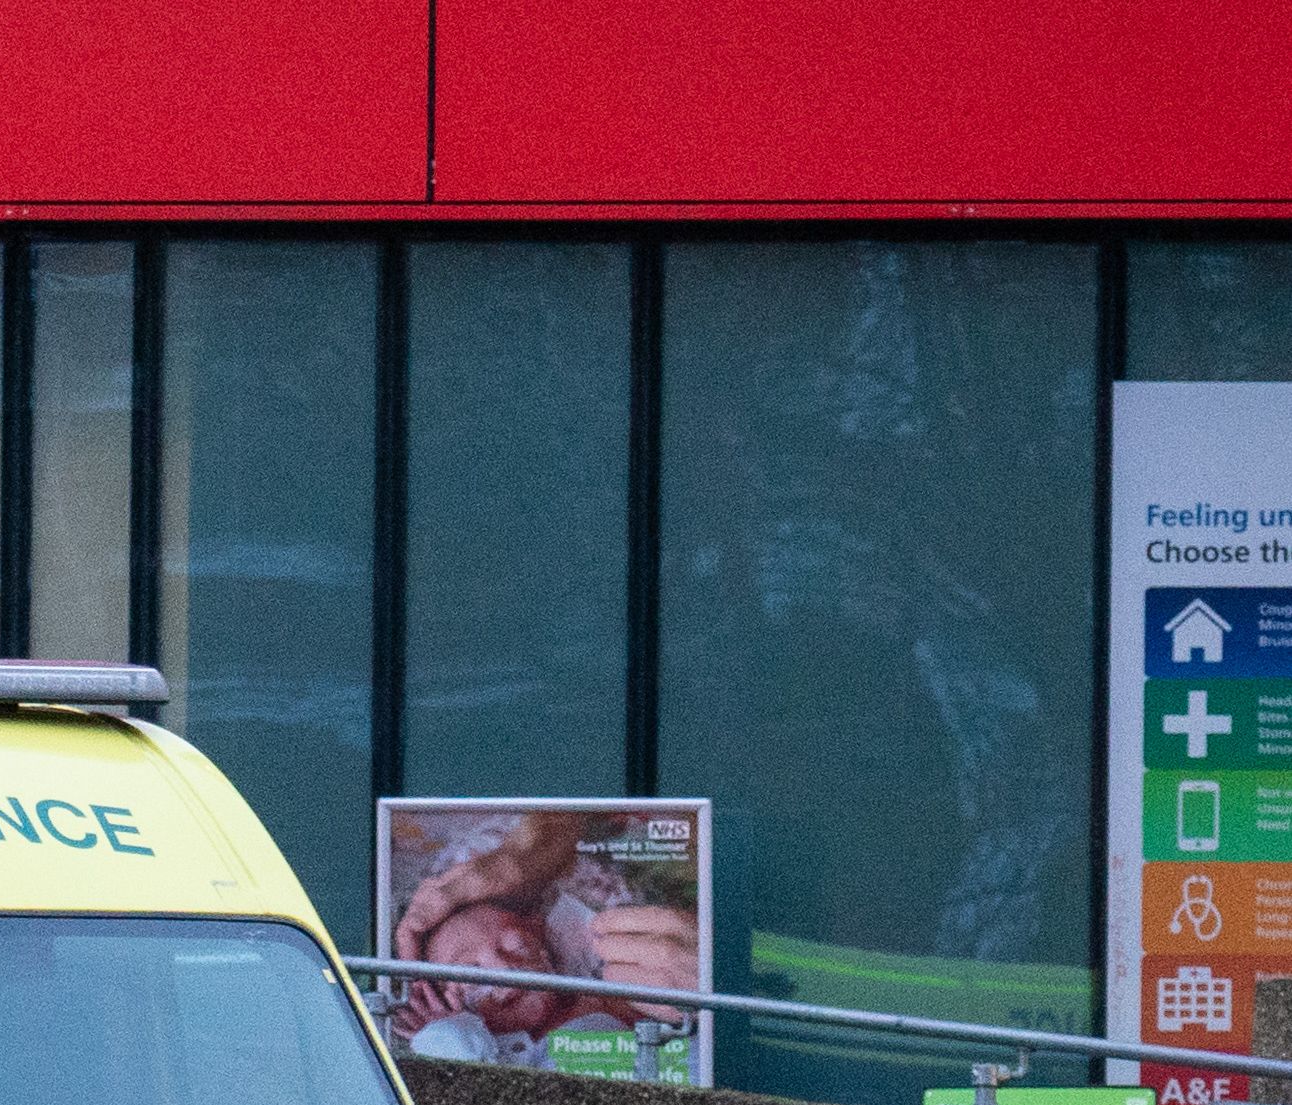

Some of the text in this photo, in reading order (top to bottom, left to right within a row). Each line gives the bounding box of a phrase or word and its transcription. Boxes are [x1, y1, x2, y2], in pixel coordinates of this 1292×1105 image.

[1147, 502, 1248, 533] Feeling
[1146, 539, 1250, 562] Choose
[652, 821, 688, 837] NHS
[553, 1036, 612, 1053] Please
